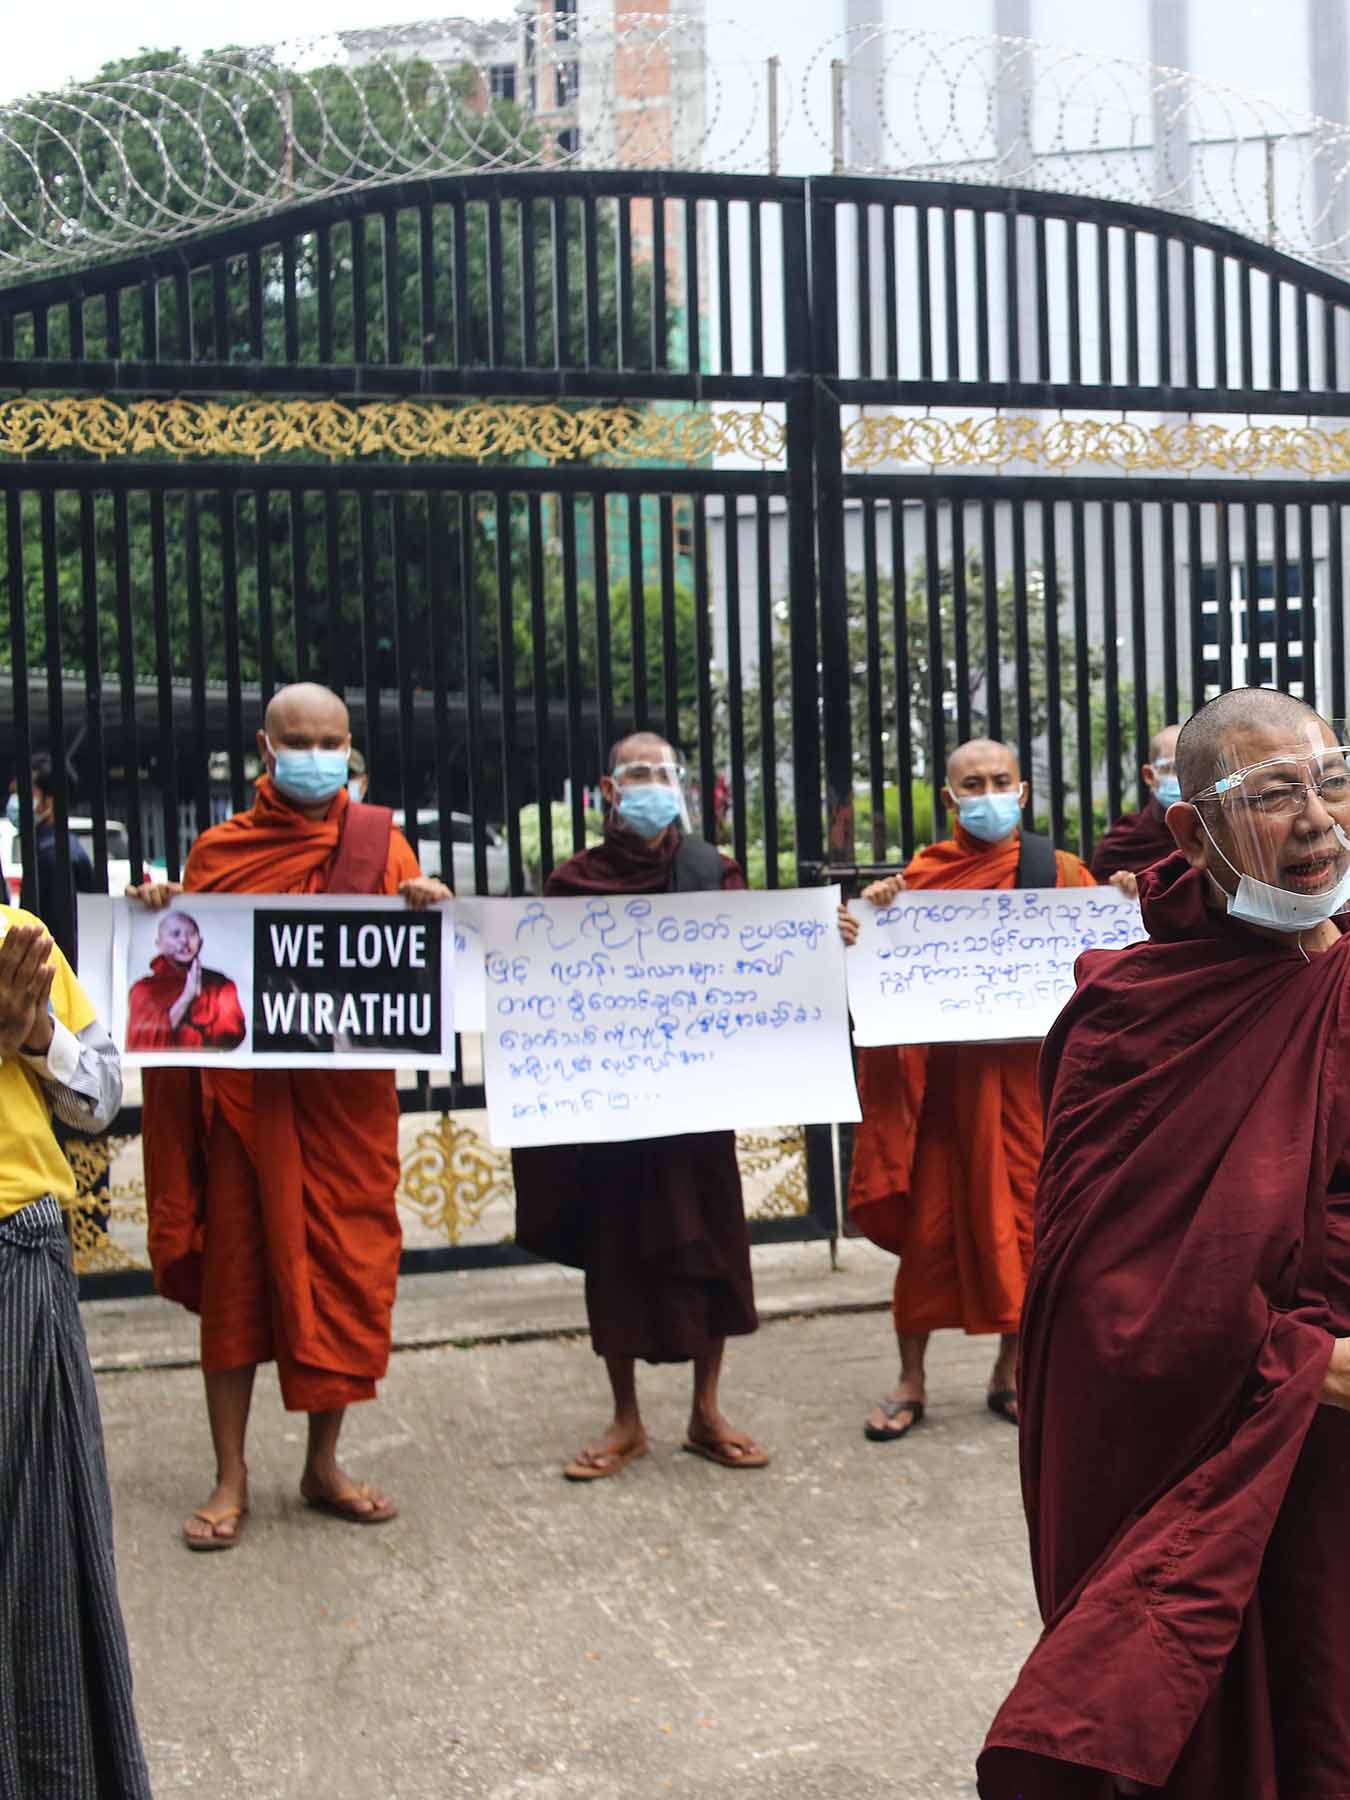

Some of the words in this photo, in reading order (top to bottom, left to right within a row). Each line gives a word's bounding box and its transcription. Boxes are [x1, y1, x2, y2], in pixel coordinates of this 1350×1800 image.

[270, 923, 324, 968] WE
[339, 924, 427, 968] LOVE
[263, 992, 431, 1036] WIRATHU
